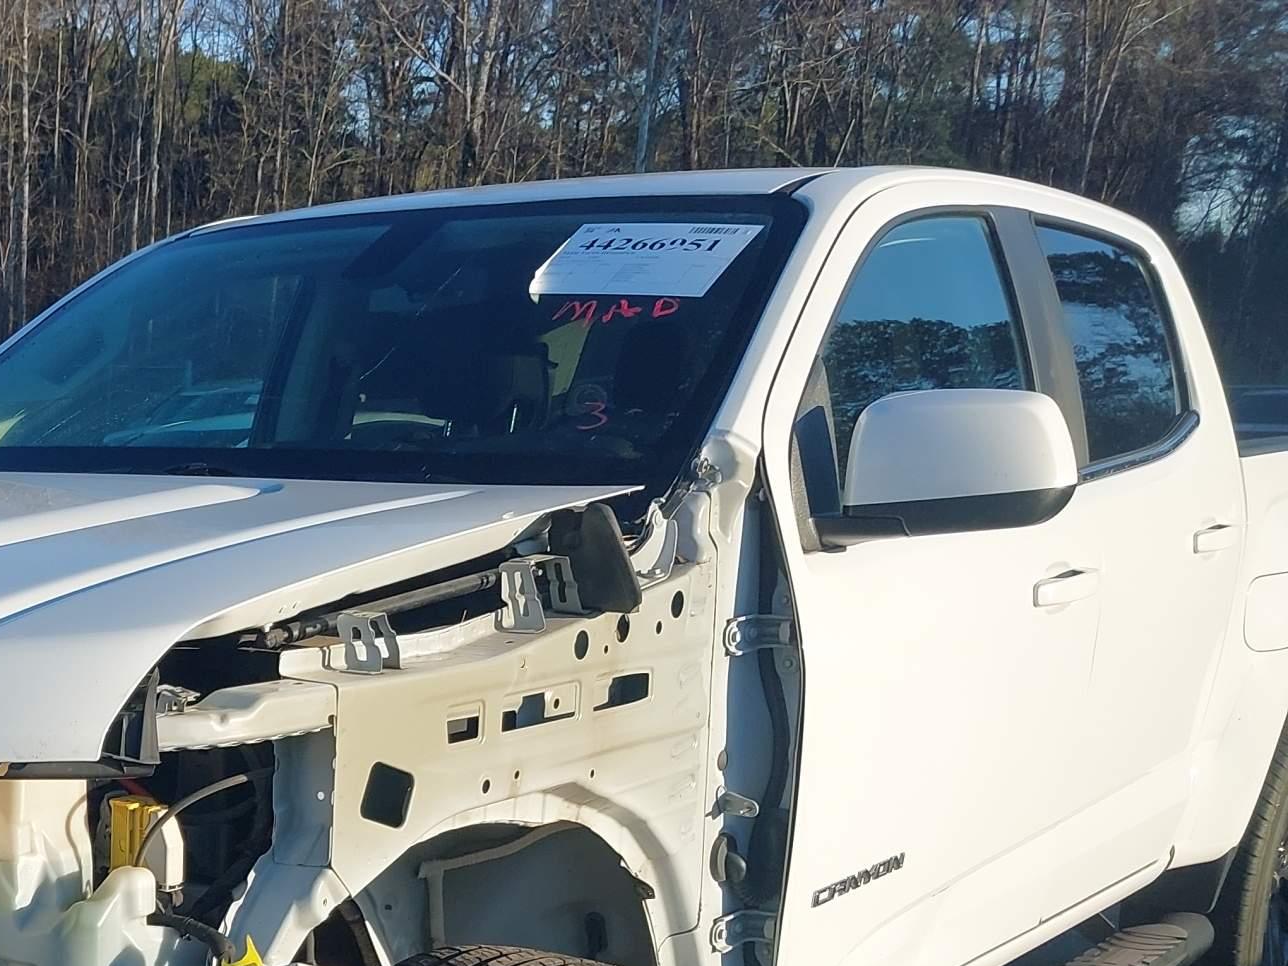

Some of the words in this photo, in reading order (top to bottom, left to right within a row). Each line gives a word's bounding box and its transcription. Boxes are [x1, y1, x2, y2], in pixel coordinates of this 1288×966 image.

[578, 237, 722, 251] 44266951
[575, 401, 608, 430] 3
[811, 852, 905, 908] CANYON
